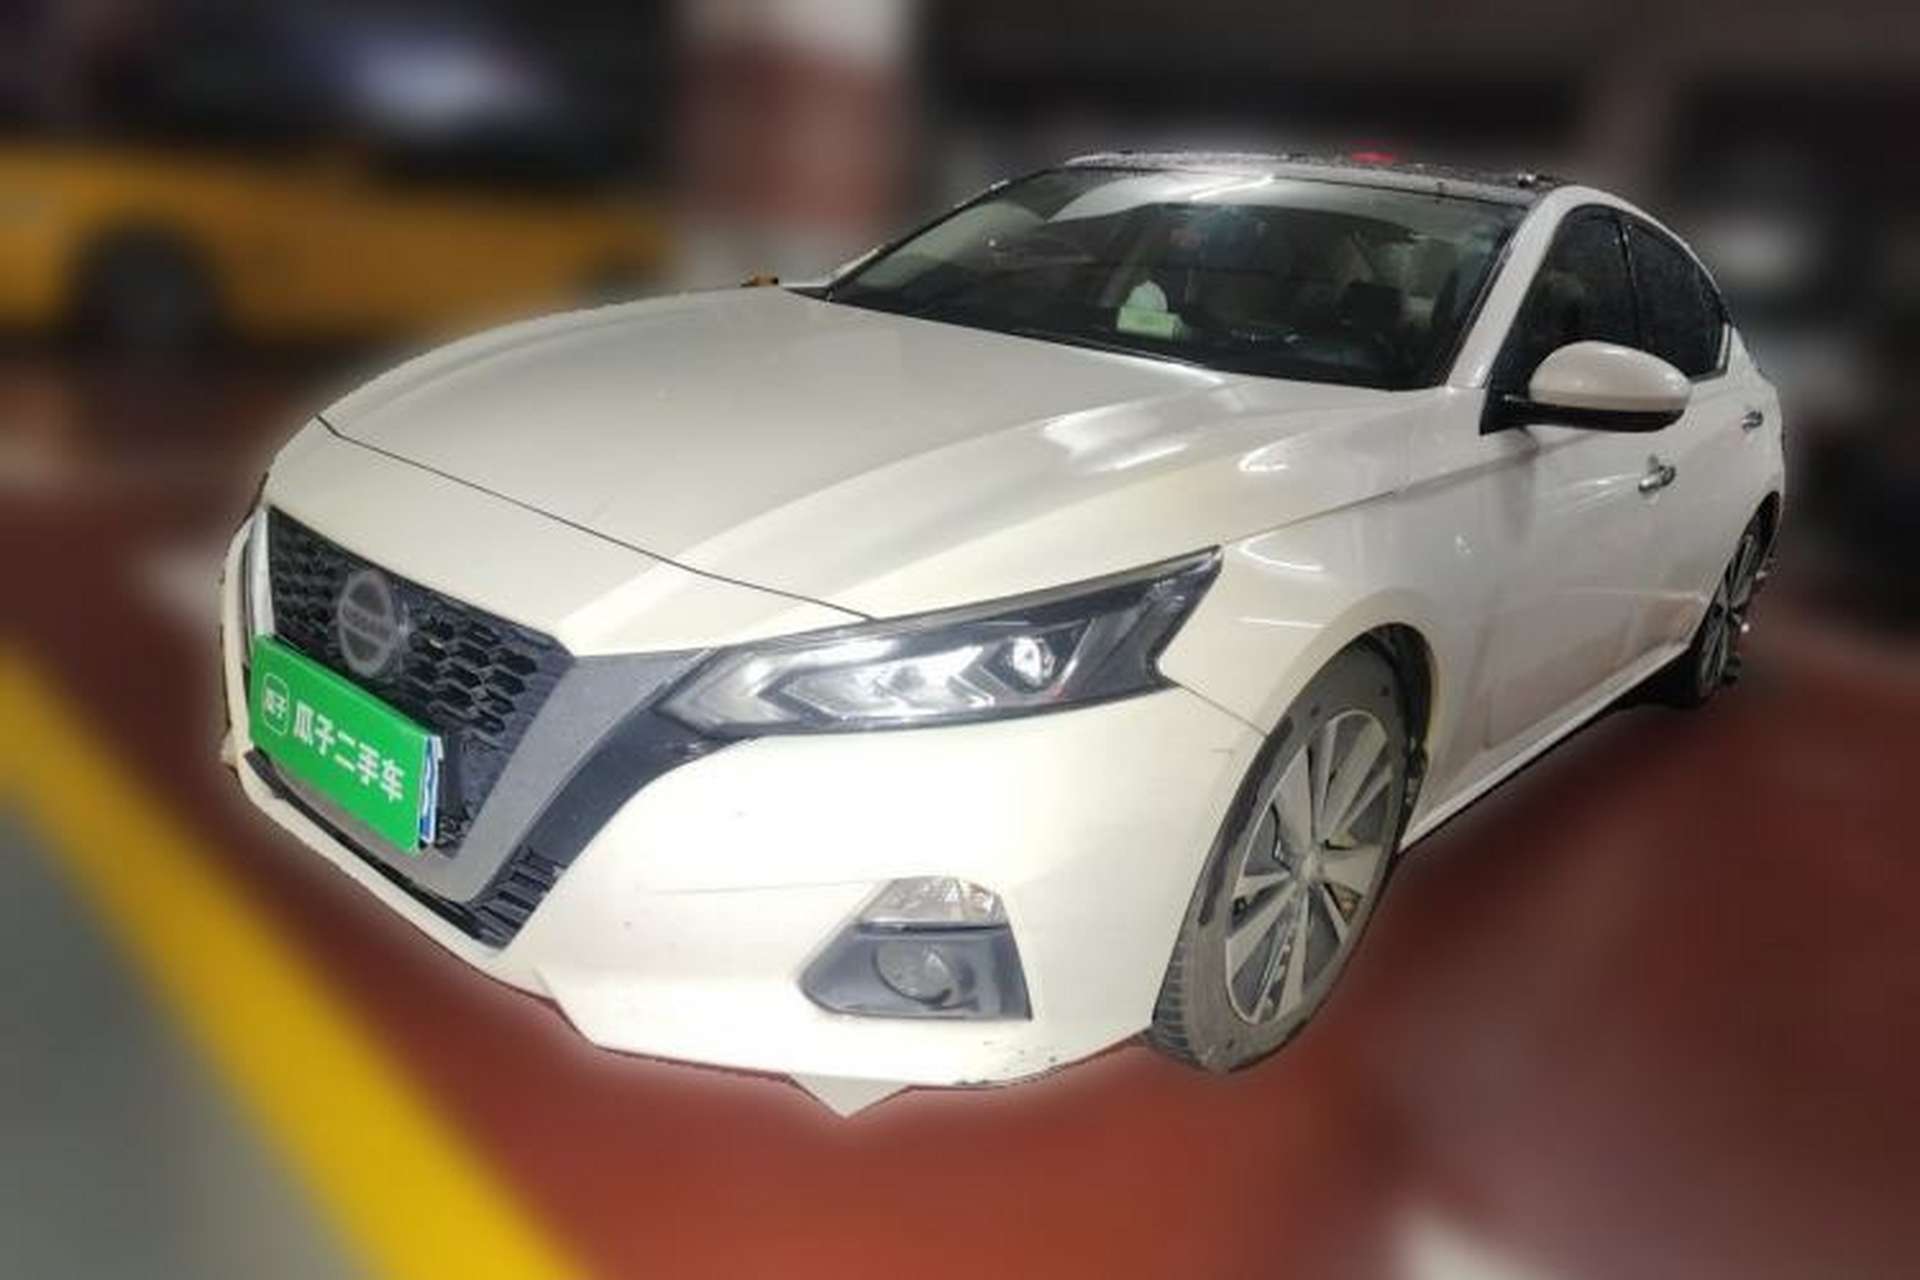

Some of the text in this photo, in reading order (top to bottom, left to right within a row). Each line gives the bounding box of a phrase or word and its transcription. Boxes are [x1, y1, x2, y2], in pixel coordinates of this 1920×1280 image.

[293, 700, 405, 803] 瓜子二手车
